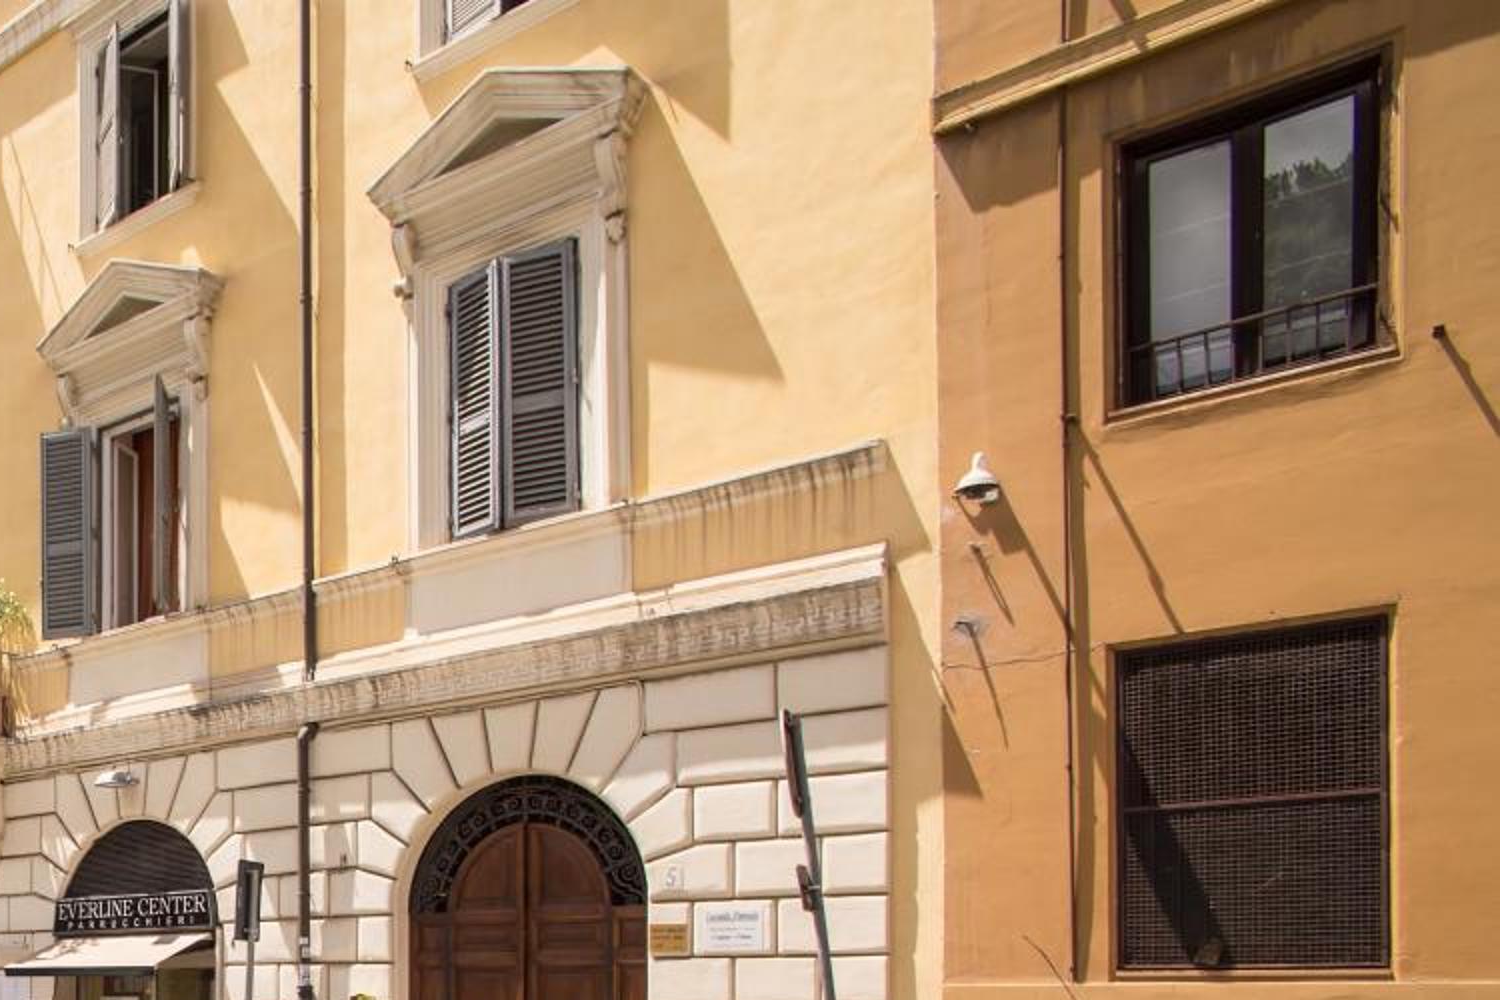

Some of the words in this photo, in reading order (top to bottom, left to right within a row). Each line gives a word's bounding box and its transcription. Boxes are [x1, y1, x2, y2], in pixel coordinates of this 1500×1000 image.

[58, 899, 133, 921] EVERLINE
[137, 895, 206, 917] CENTER
[68, 915, 195, 930] PARRUCCHIERI
